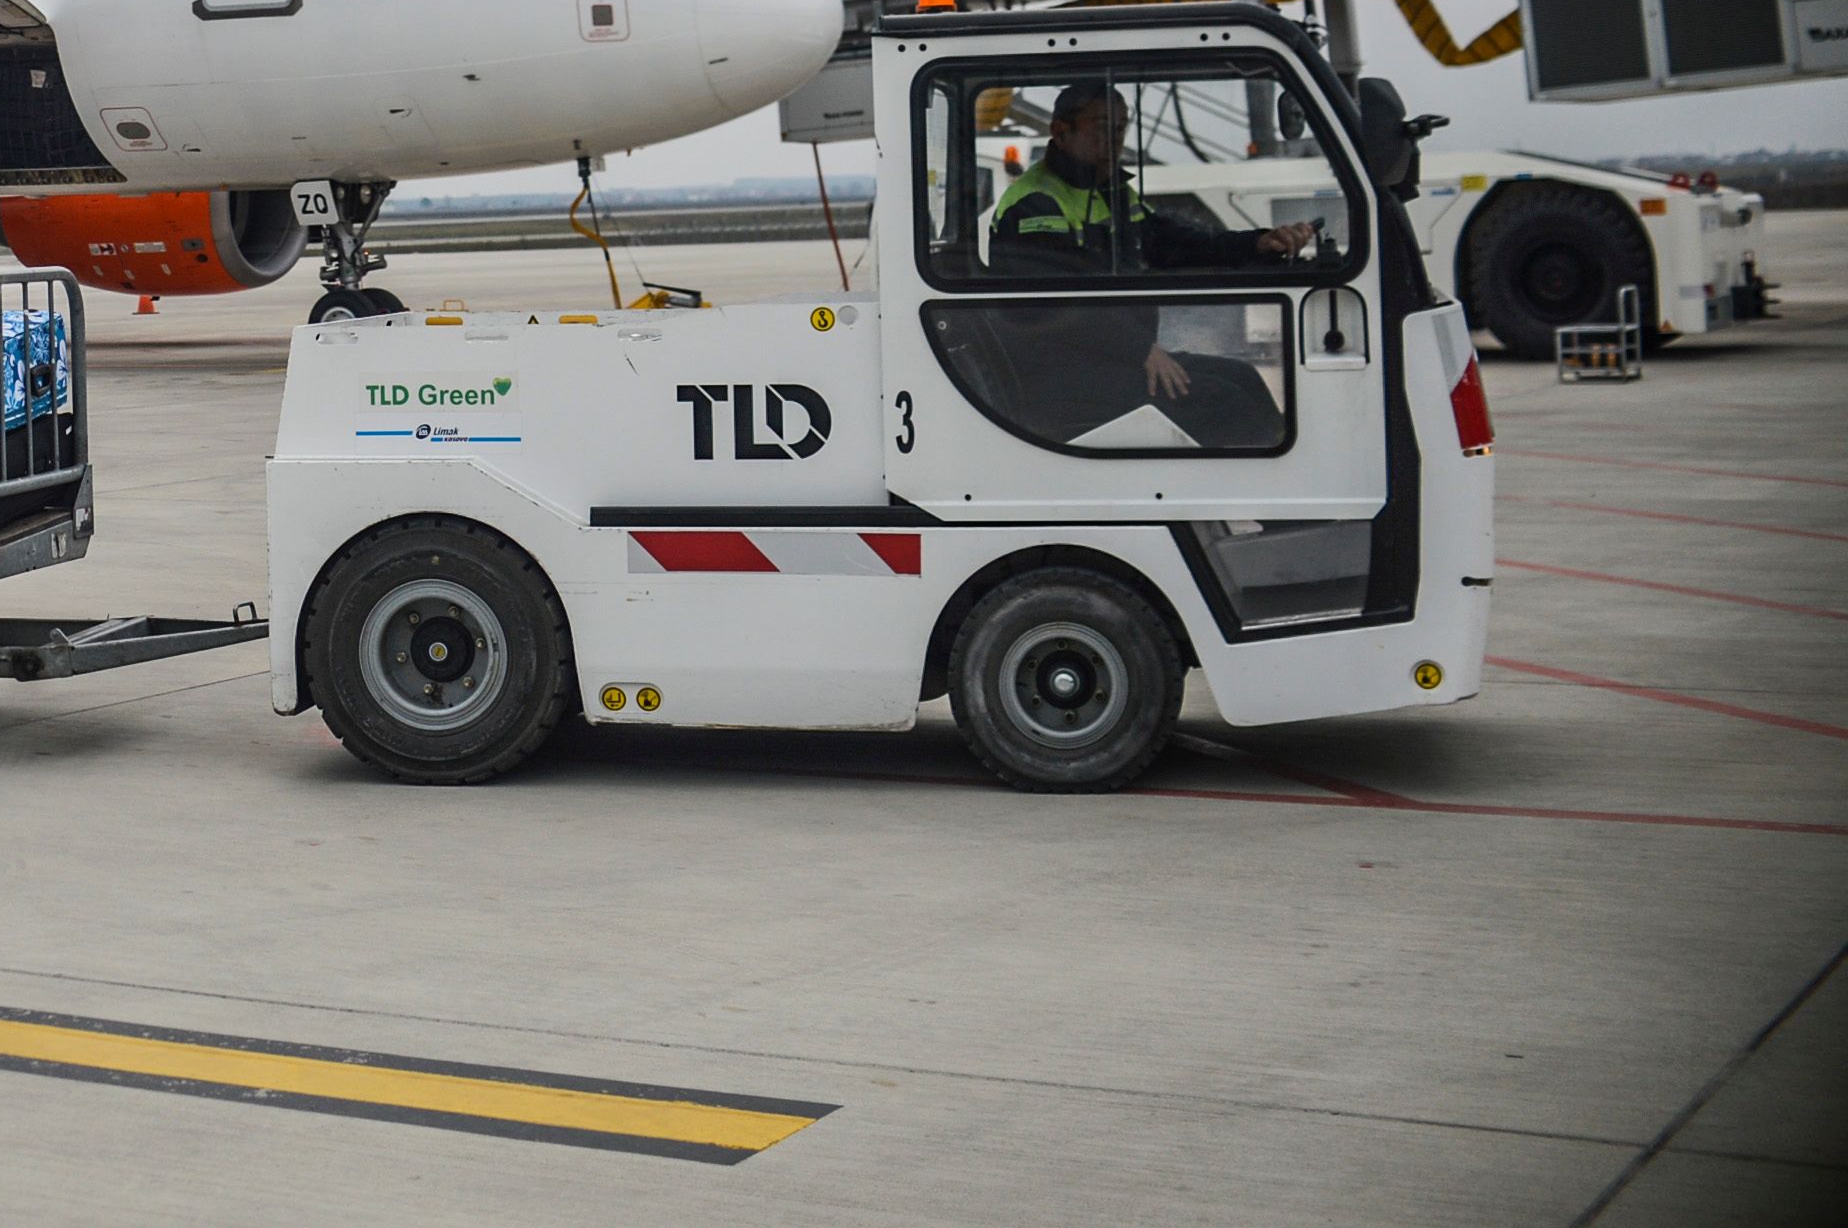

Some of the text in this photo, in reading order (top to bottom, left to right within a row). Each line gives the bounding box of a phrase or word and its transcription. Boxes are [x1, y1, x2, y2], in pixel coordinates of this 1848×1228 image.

[365, 384, 495, 406] TLD Green
[676, 384, 832, 460] TLD
[895, 390, 915, 454] 3
